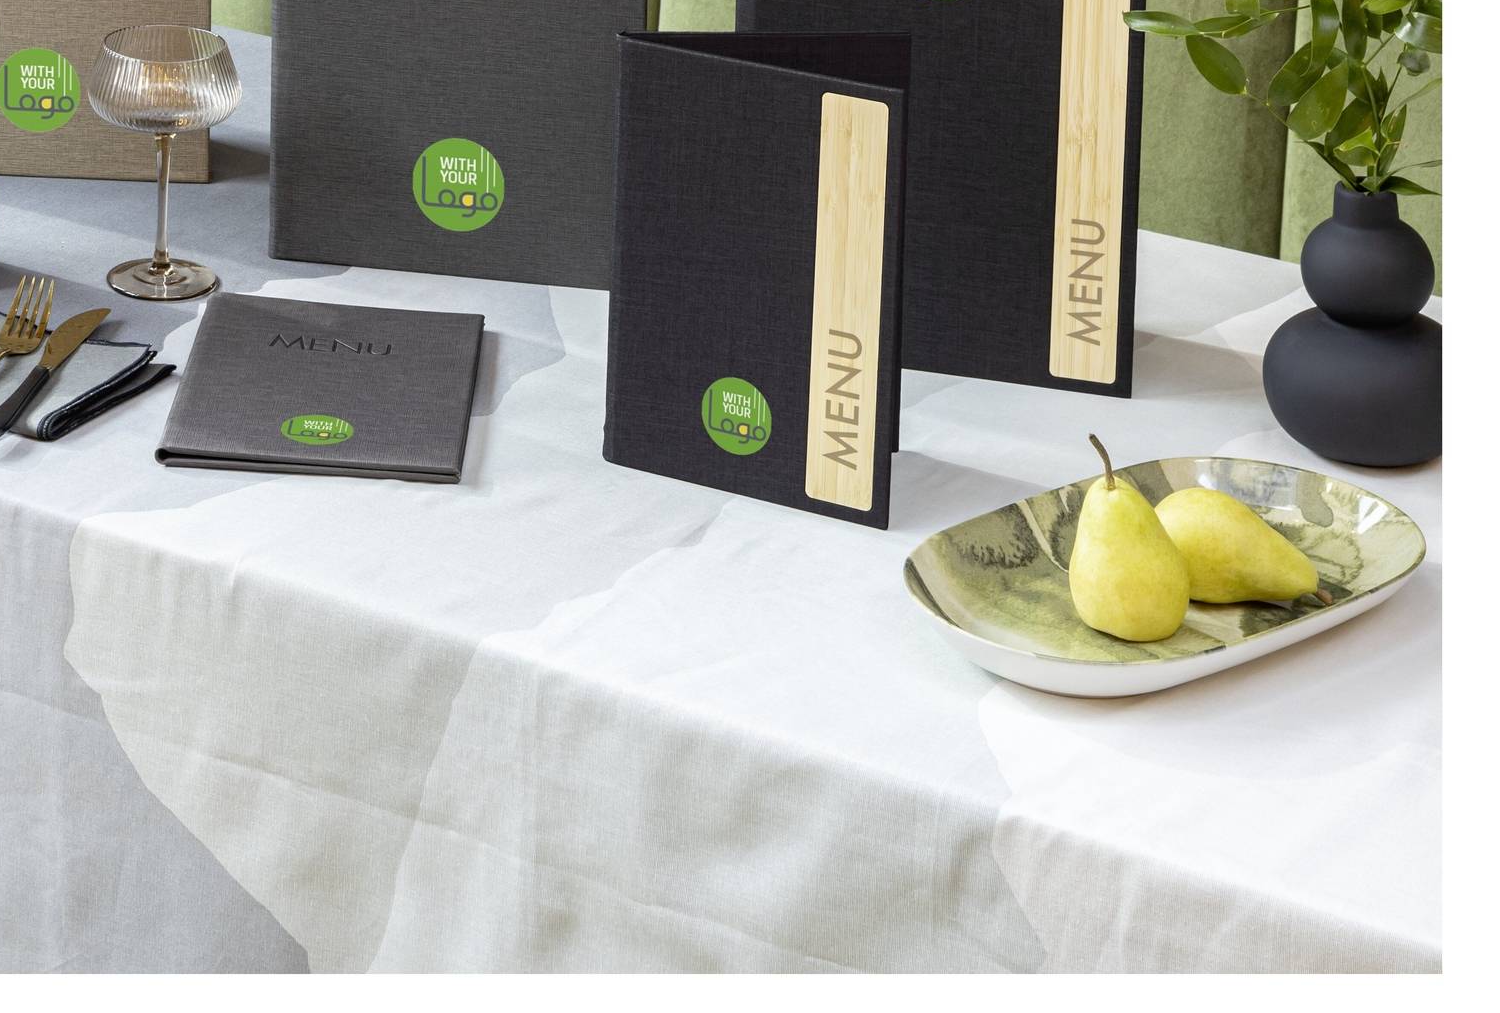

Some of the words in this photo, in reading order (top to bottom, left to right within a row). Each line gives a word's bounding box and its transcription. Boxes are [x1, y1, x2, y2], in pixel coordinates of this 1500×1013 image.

[20, 65, 55, 78] WITH
[20, 77, 55, 90] YOUR
[439, 156, 477, 172] WITH
[439, 170, 477, 186] YOUR
[1065, 217, 1108, 348] MENU
[268, 333, 394, 358] MENU
[722, 391, 751, 406] WITH
[821, 329, 864, 471] MENU
[722, 403, 751, 418] YOUR
